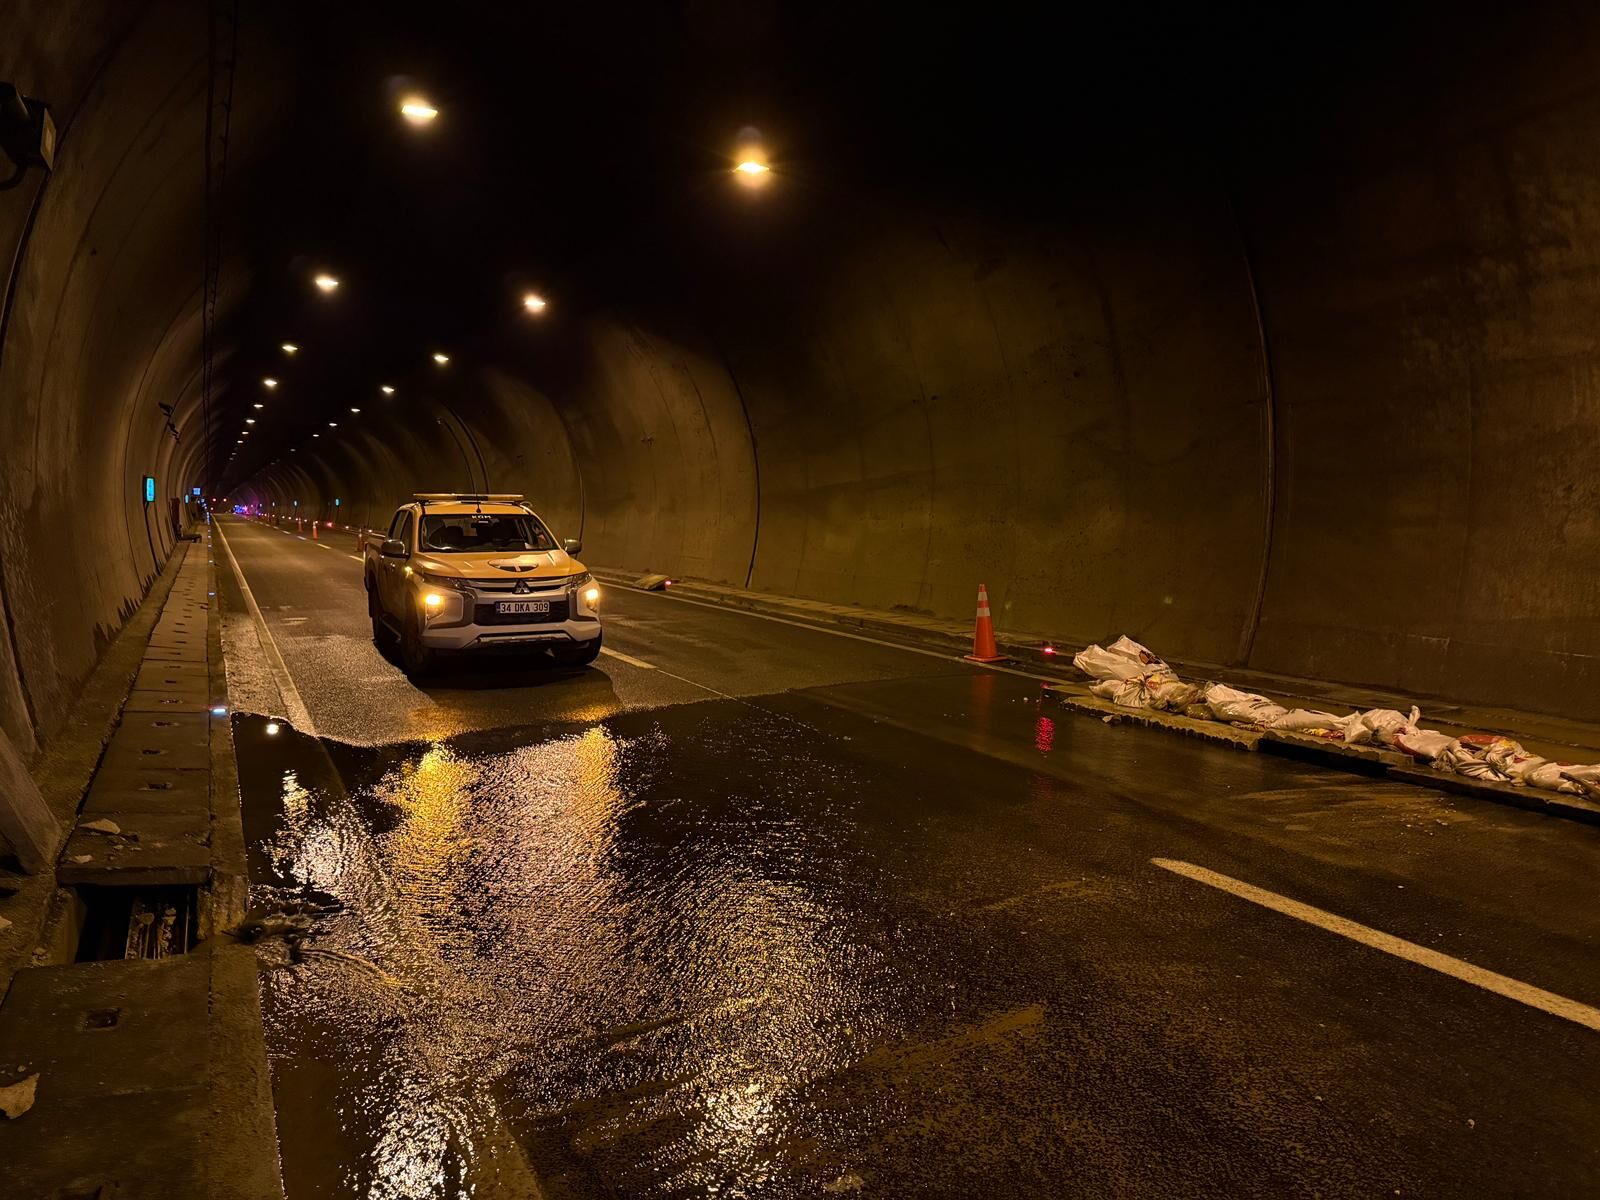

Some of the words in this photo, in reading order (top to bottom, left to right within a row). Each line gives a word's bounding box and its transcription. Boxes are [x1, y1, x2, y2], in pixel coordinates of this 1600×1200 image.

[501, 603, 511, 612] 34
[514, 603, 530, 612] DKA
[533, 603, 549, 612] 309
